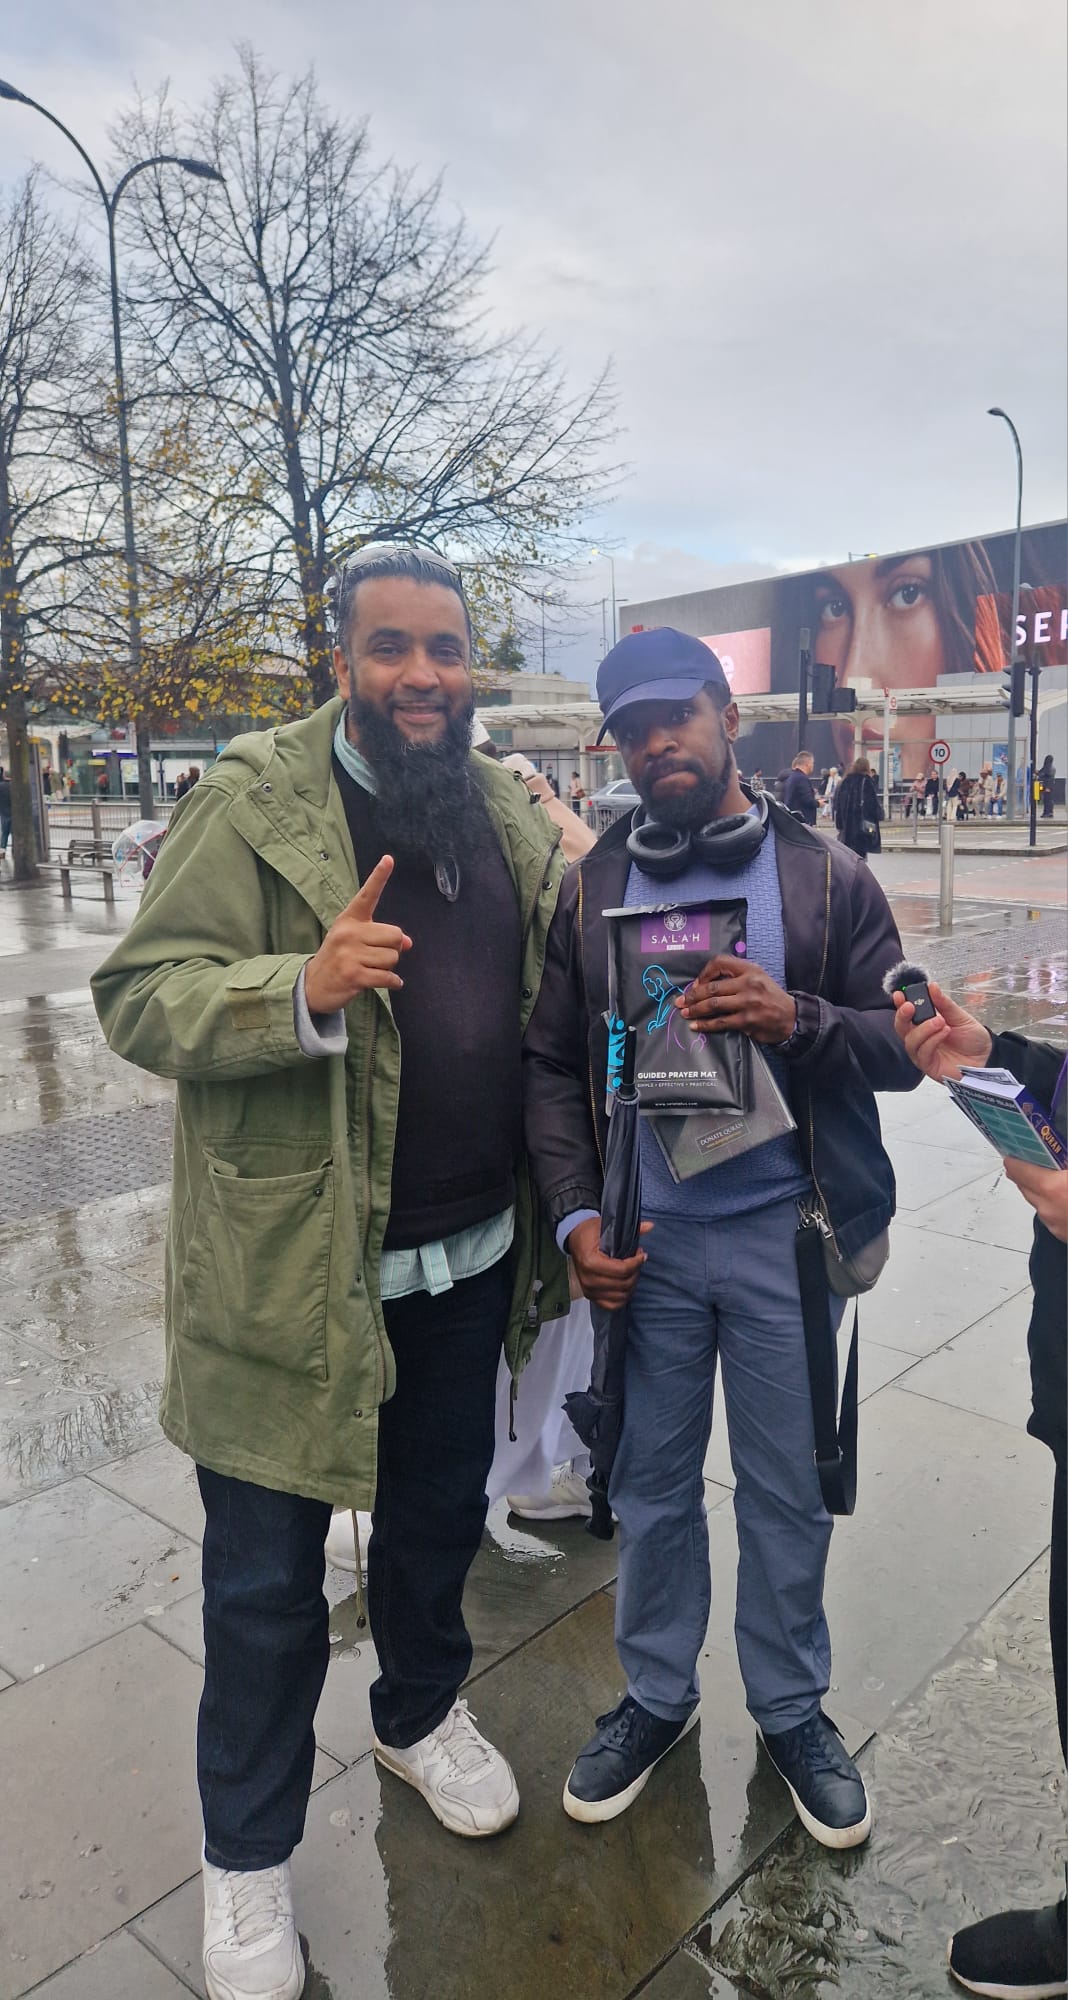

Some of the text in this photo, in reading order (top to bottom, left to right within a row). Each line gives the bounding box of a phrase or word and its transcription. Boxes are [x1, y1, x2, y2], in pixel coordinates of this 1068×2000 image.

[935, 748, 946, 758] 10
[700, 1131, 724, 1146] DONATE
[1041, 1125, 1063, 1154] QURAN
